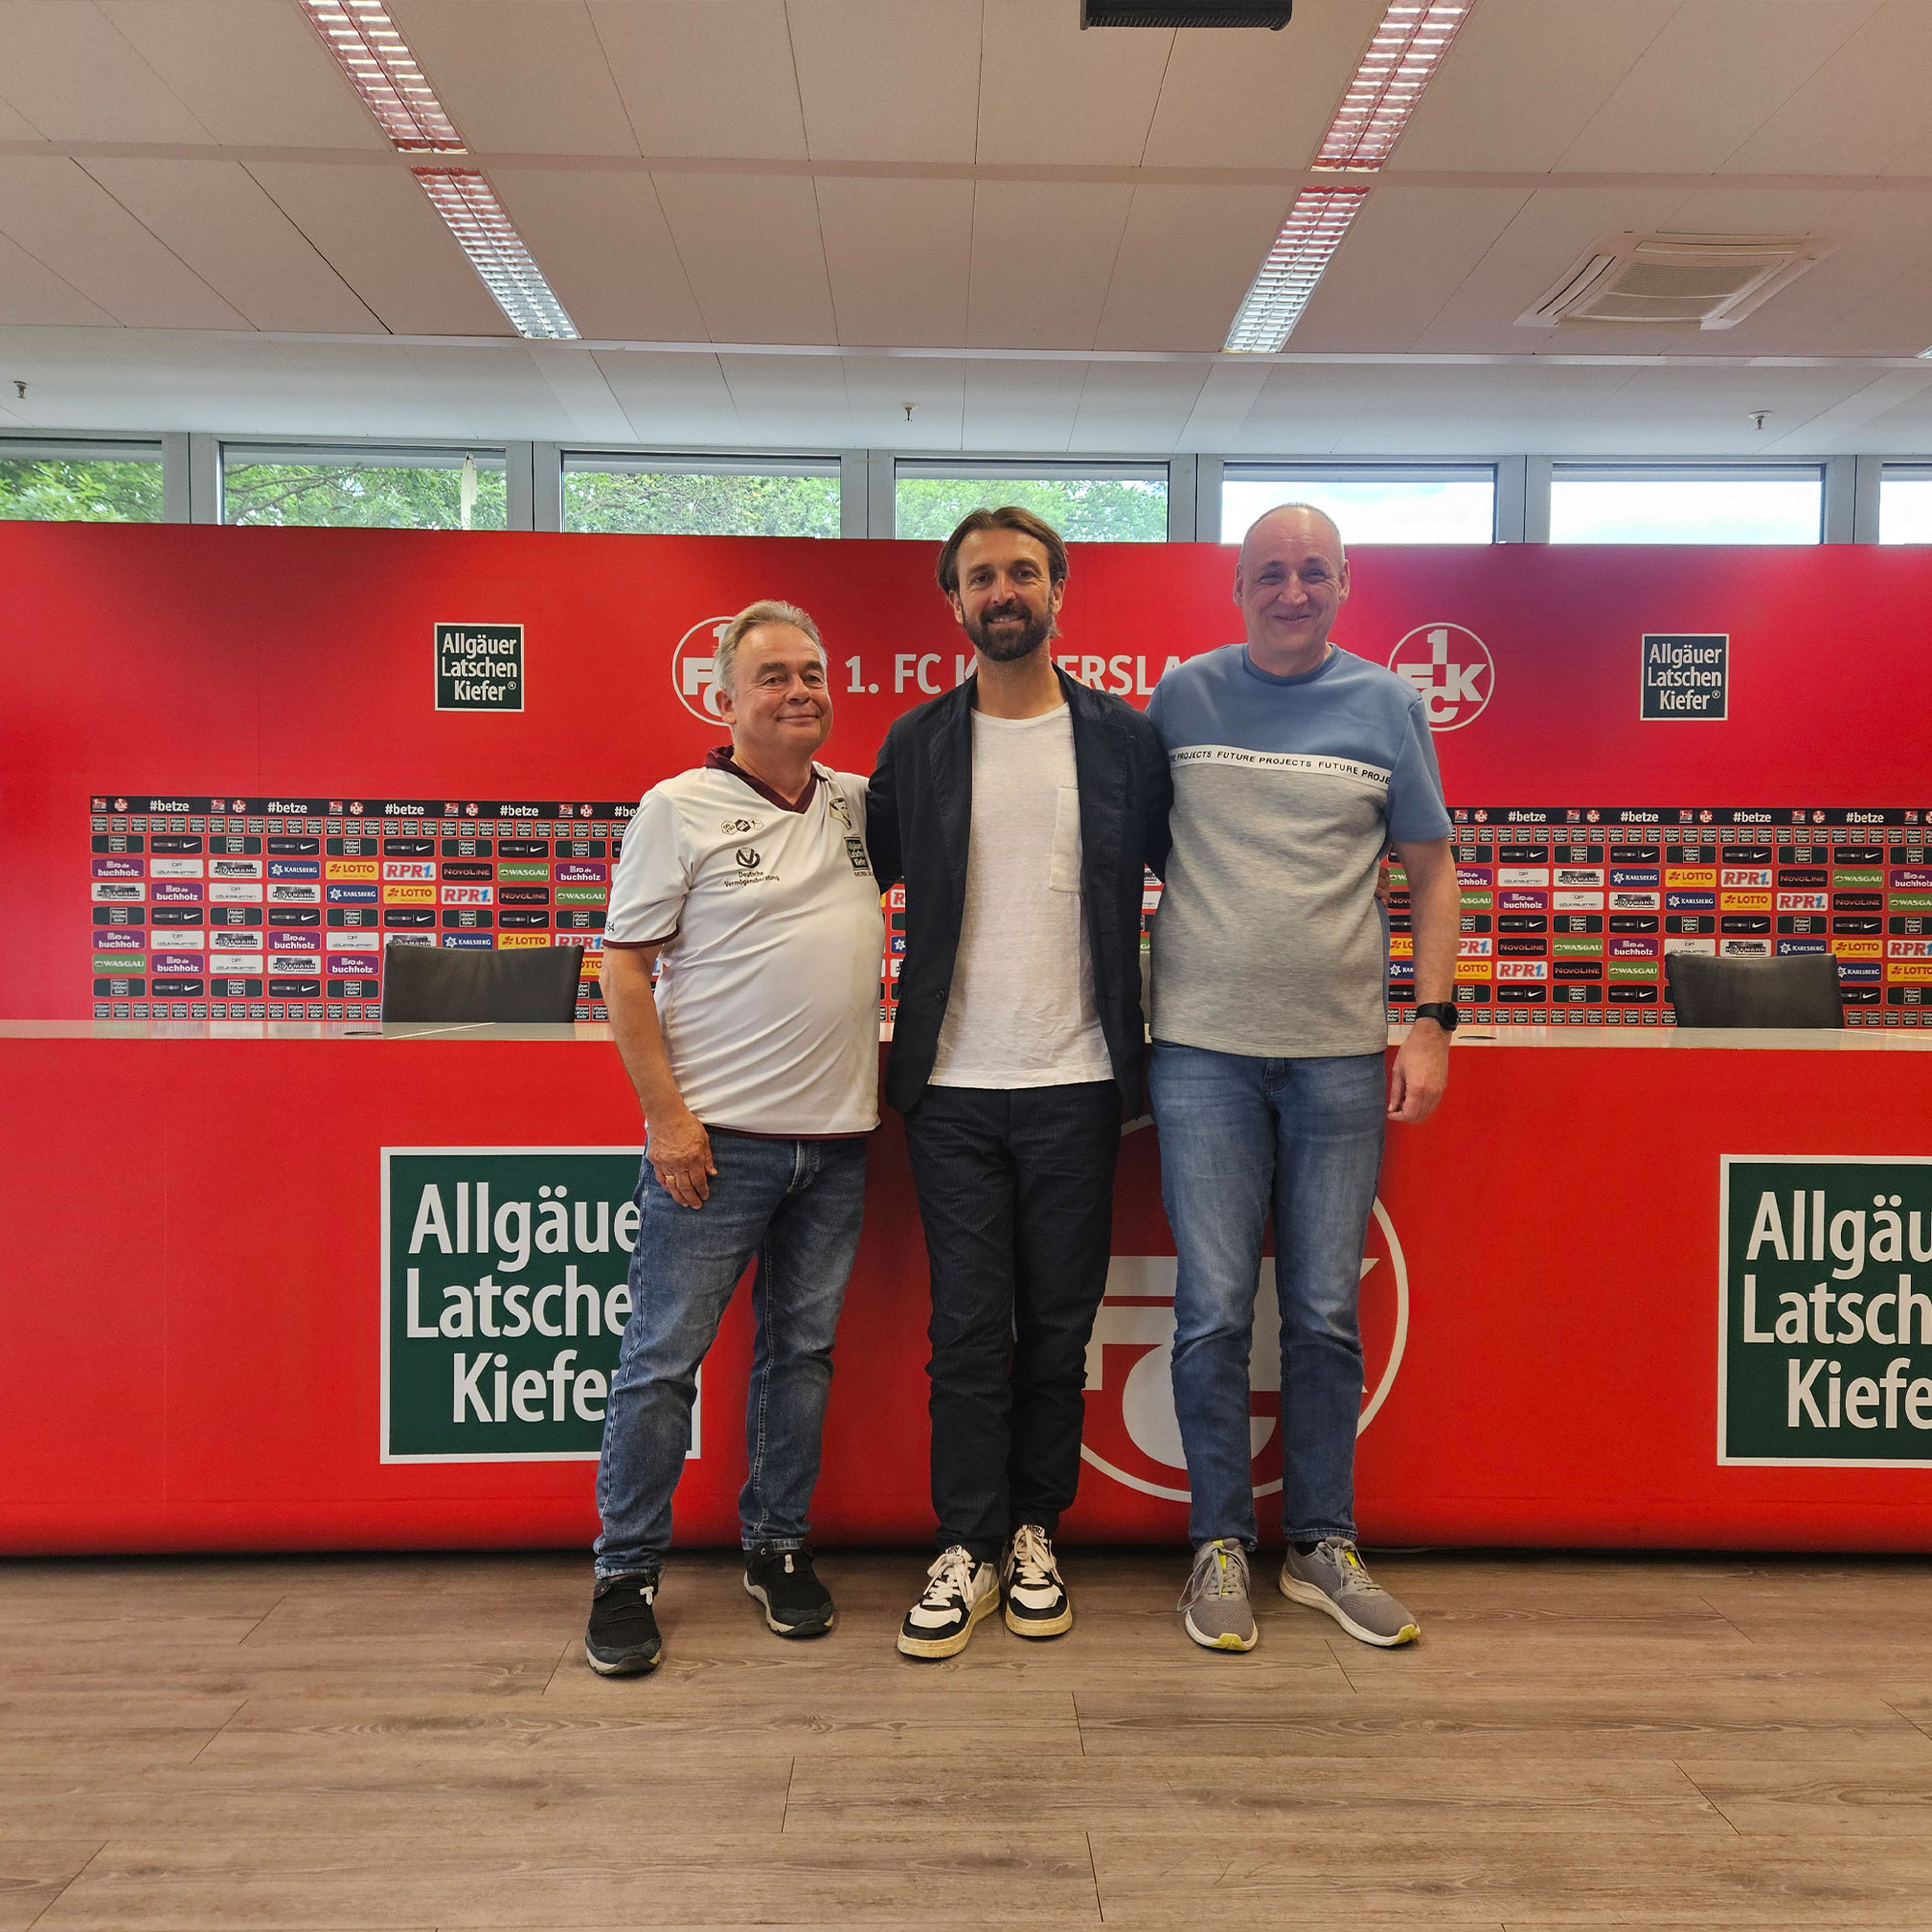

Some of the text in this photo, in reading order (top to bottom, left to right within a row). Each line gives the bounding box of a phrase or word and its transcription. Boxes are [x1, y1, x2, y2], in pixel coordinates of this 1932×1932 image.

[443, 633, 516, 659] Allgäuer
[1649, 644, 1722, 669] Allgäuer
[443, 657, 517, 677] Latschen
[846, 655, 879, 693] 1.
[896, 654, 941, 694] FC
[1648, 667, 1721, 687] Latschen
[1177, 751, 1212, 761] PROJECTS
[1217, 752, 1255, 762] FUTURE
[1259, 758, 1311, 767] PROJECTS
[1318, 761, 1358, 774] FUTURE
[150, 801, 189, 811] #betze
[268, 803, 307, 813] #betze
[385, 805, 423, 815] #betze
[500, 806, 538, 816] #betze
[1509, 811, 1546, 822] #betze
[1621, 812, 1658, 823] #betze
[1734, 812, 1771, 823] #betze
[1847, 813, 1883, 823] #betze
[343, 864, 375, 874] LOTTO
[724, 875, 780, 887] Vermögensberatung
[99, 940, 139, 948] buchholz
[516, 937, 546, 945] LOTTO
[1460, 941, 1489, 953] PR1.
[408, 1182, 640, 1272] Allgäue
[407, 1265, 632, 1337] Latsche
[453, 1350, 619, 1422] Kiefe
